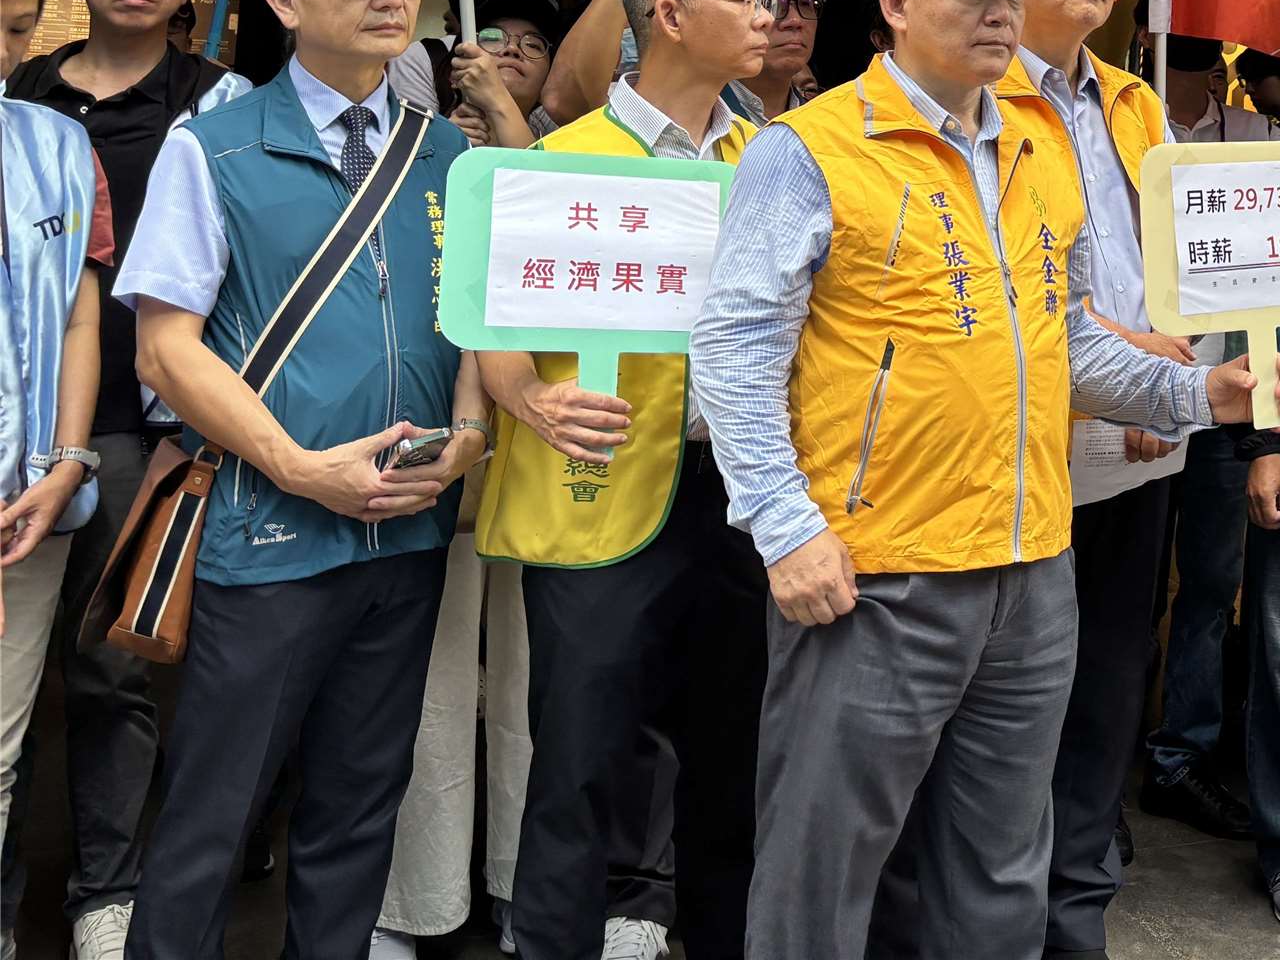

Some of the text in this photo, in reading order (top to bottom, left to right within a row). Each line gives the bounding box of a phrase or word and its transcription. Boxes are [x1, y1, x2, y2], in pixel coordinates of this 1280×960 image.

[1185, 188, 1227, 215] 月薪
[567, 201, 650, 233] 共享
[1188, 238, 1232, 265] 時薪
[522, 258, 688, 295] 經濟果實
